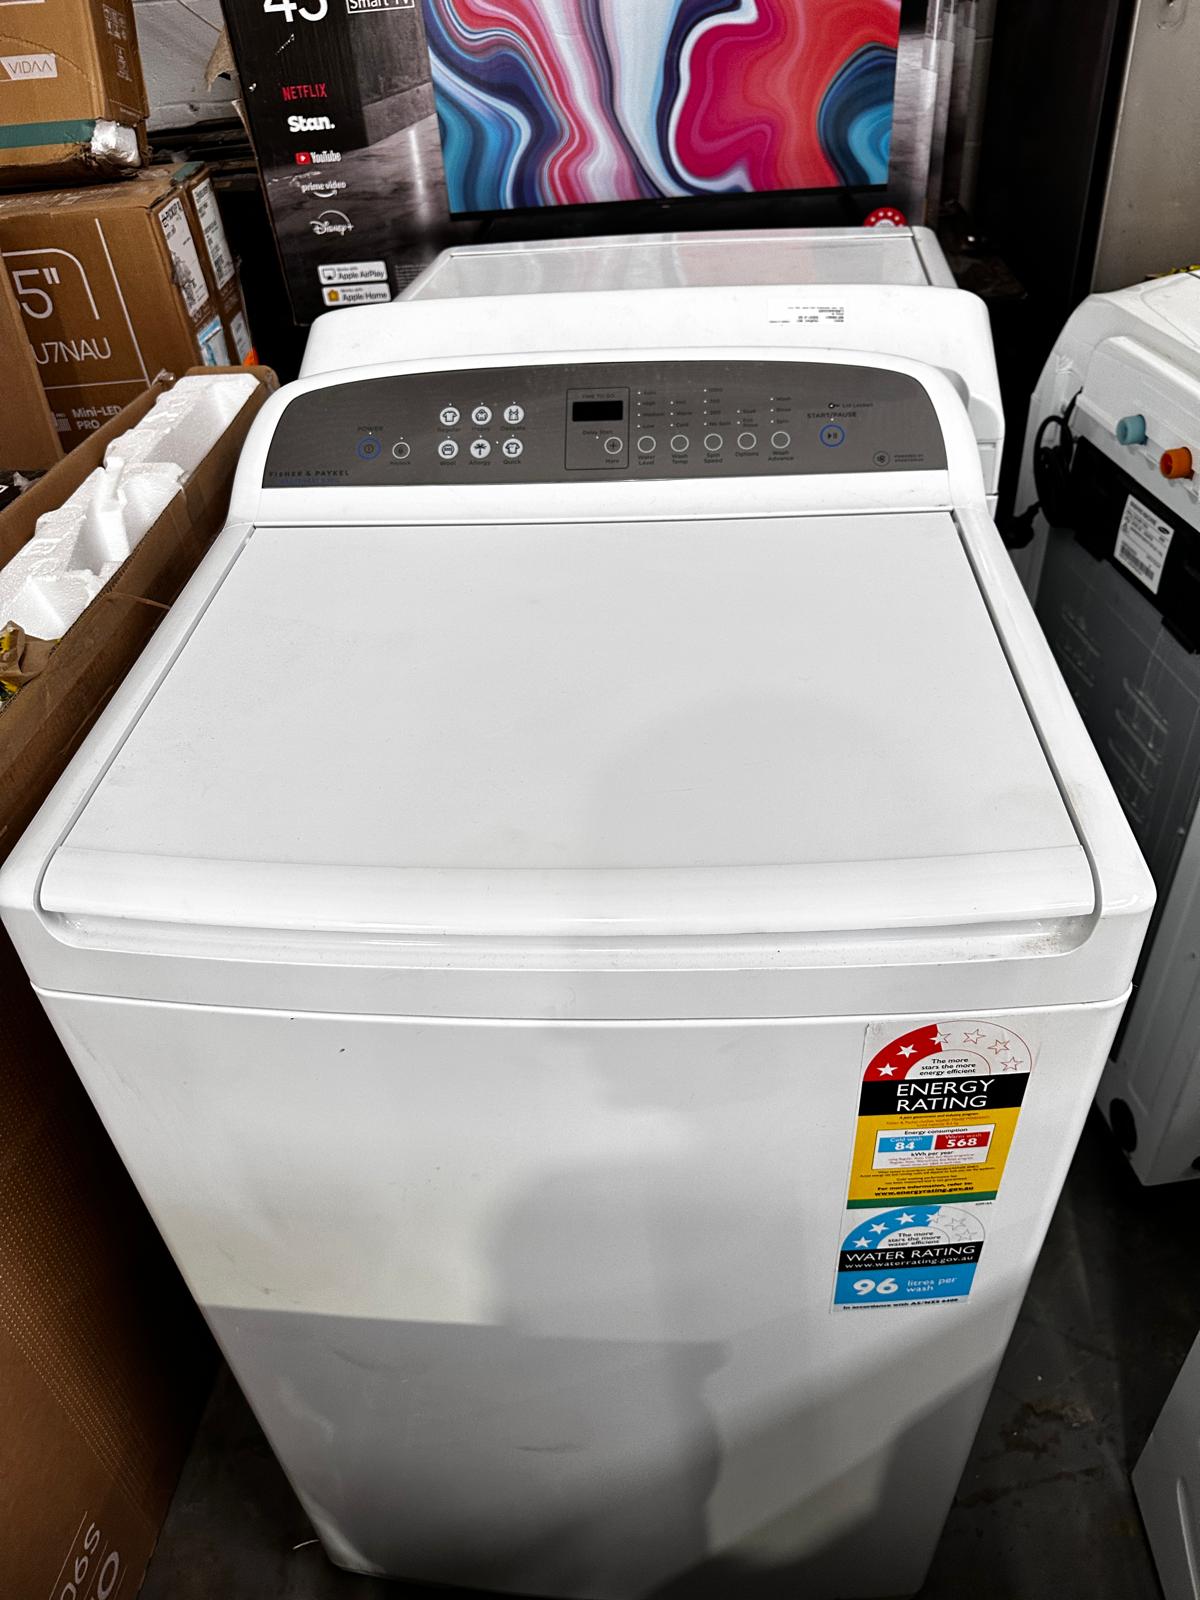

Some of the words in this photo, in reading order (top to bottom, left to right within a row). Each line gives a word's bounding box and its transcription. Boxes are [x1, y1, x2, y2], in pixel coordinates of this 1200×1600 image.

[8, 60, 52, 74] VIDAA
[282, 83, 328, 101] NETFLIX
[288, 115, 336, 132] Stan.
[310, 150, 342, 164] YouTube
[301, 182, 325, 194] prime
[325, 180, 346, 190] video
[310, 217, 354, 236] Disney+
[339, 272, 358, 280] Apple
[360, 270, 385, 279] AirPlay
[343, 294, 363, 302] Apple
[72, 405, 122, 418] Mini-LED
[76, 418, 100, 430] PRO
[896, 1078, 995, 1096] ENERGY
[896, 1095, 988, 1112] RATING
[894, 1141, 916, 1151] 84
[946, 1137, 978, 1148] 568
[846, 1251, 905, 1262] WATER
[911, 1246, 976, 1258] RATING
[844, 1256, 973, 1269] www.waterrating.gov.au
[852, 1277, 899, 1296] 96
[938, 1278, 958, 1286] per
